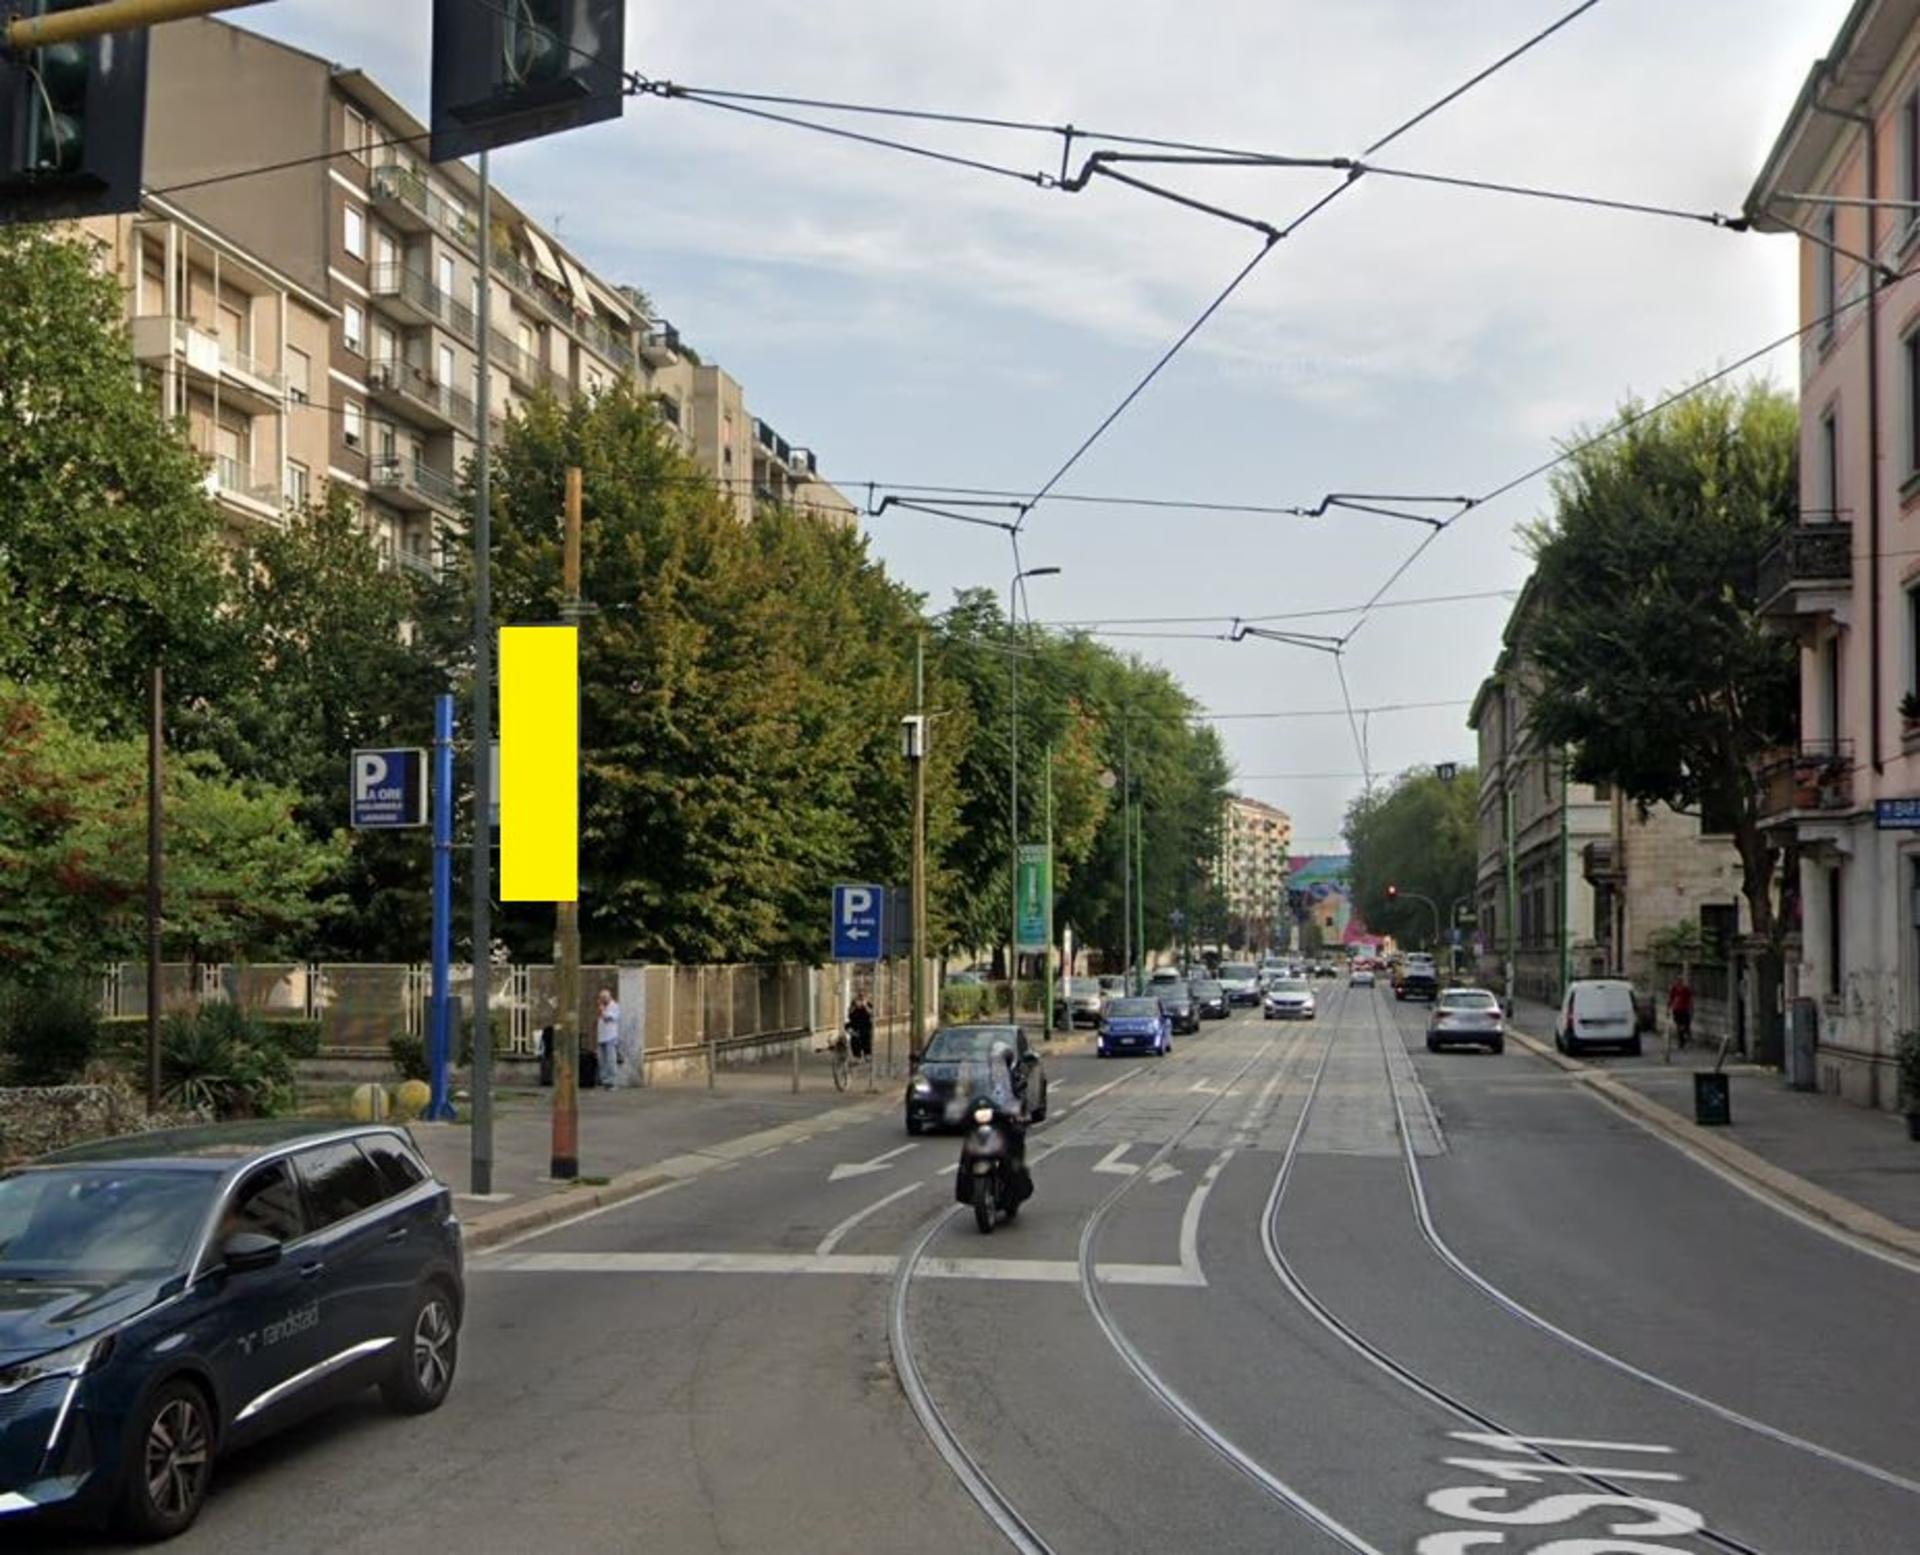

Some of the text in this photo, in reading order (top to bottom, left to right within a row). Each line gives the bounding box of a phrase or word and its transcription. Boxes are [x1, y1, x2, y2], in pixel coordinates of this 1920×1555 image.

[356, 755, 387, 800] P
[843, 888, 872, 925] P
[263, 1298, 319, 1346] randstad
